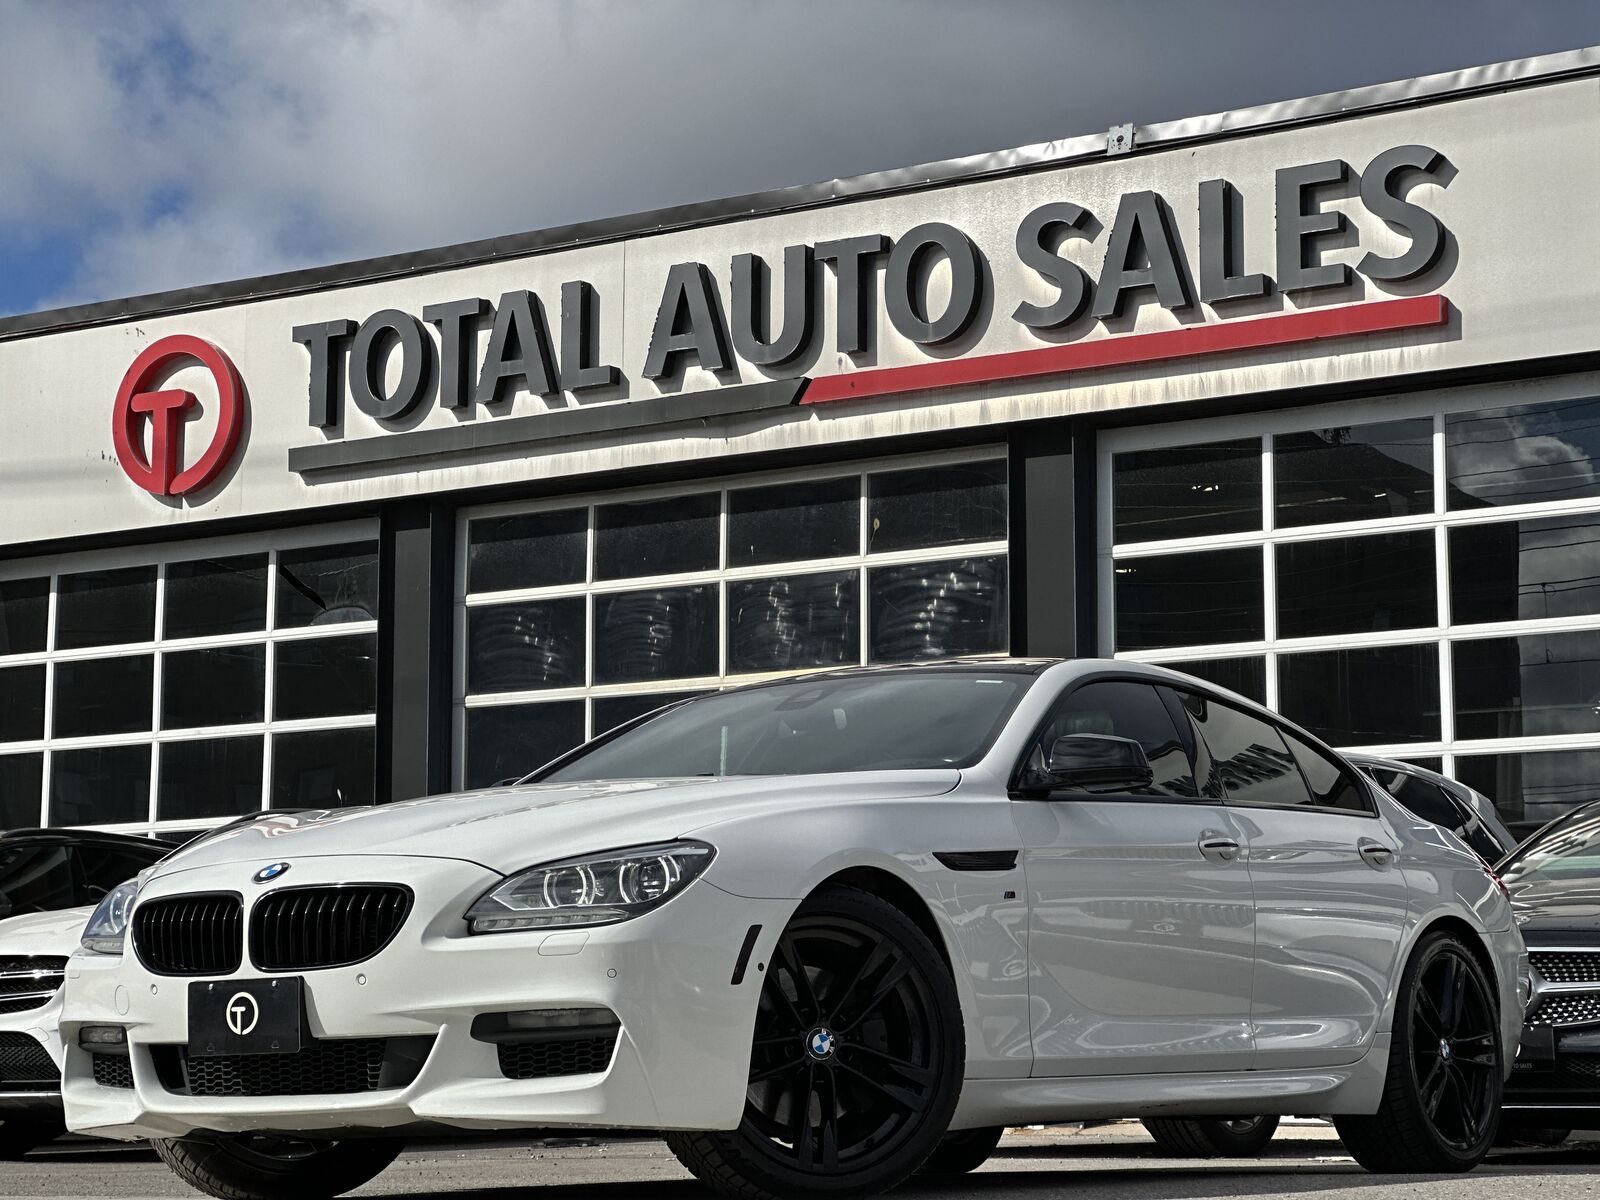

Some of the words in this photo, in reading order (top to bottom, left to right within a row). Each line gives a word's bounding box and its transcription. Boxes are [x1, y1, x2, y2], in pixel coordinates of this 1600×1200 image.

[292, 280, 619, 426] TOTAL
[641, 222, 984, 379] AUTO
[1011, 144, 1448, 328] SALES
